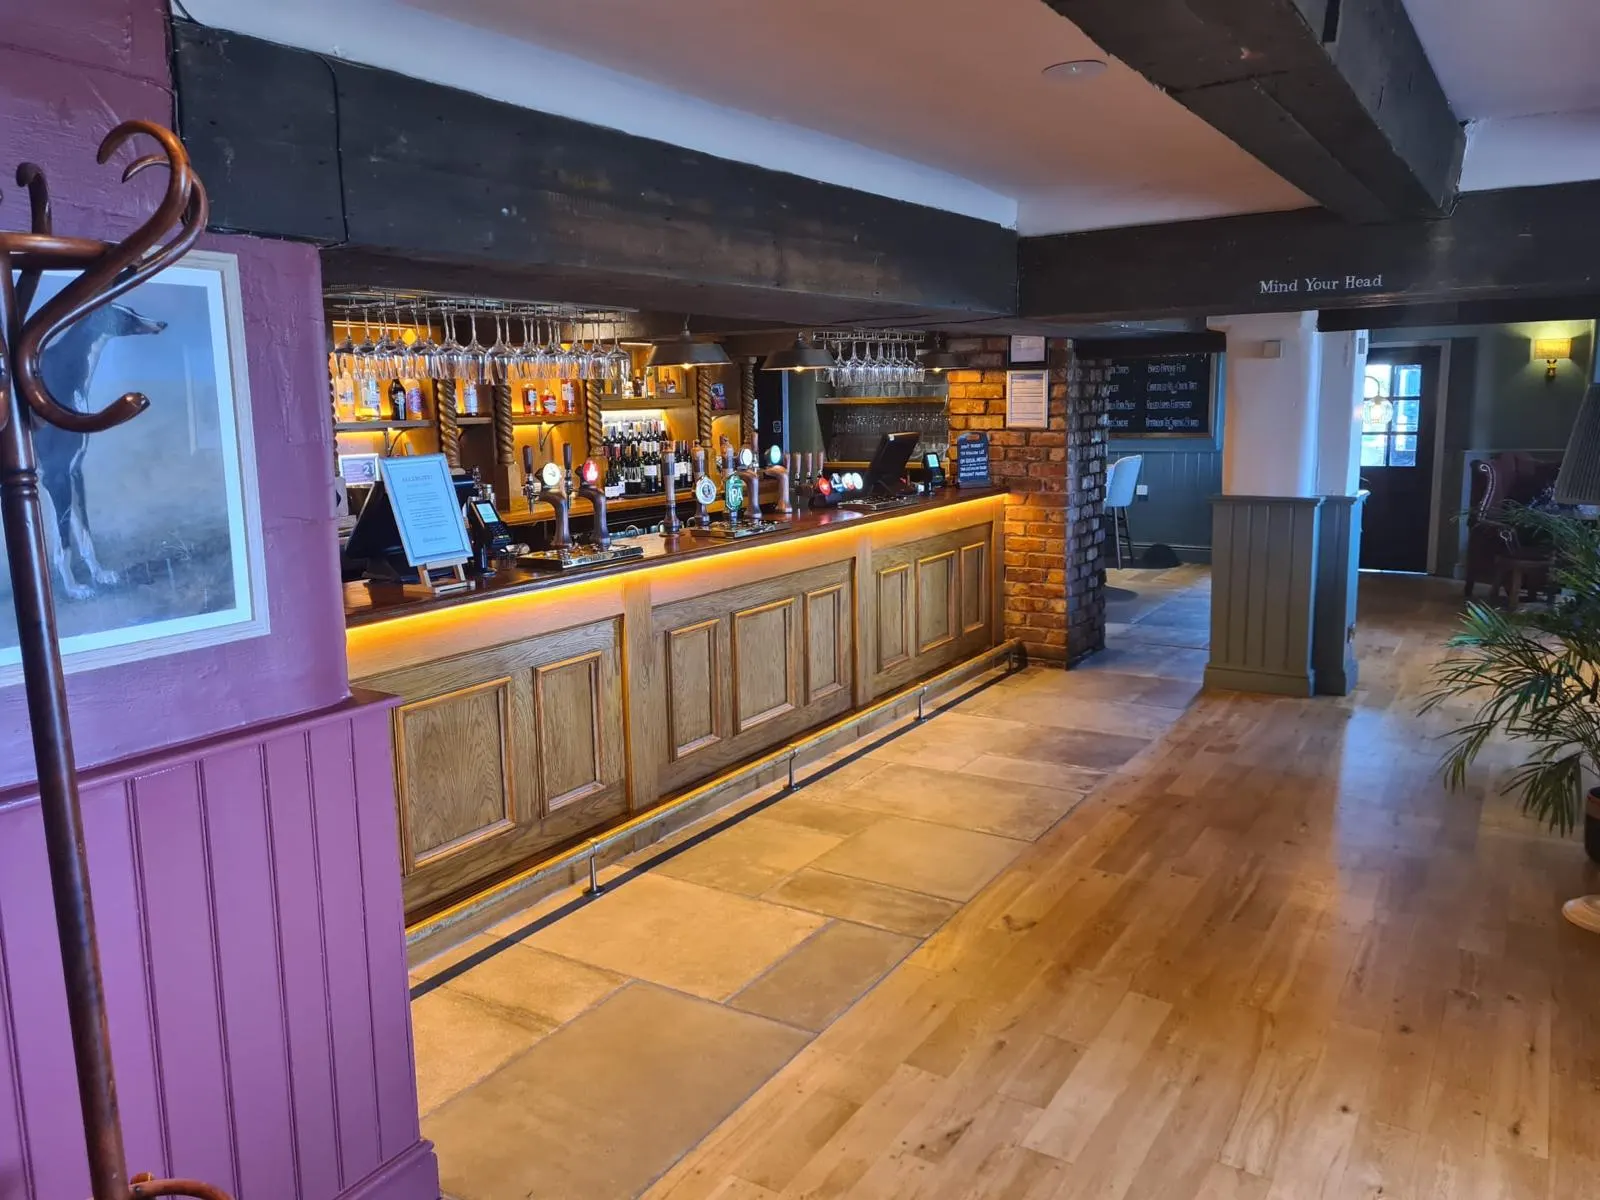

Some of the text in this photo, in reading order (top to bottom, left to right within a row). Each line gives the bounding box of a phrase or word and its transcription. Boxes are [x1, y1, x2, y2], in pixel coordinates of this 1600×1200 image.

[1260, 275, 1383, 293] Mind Your Head
[728, 487, 744, 503] IPA
